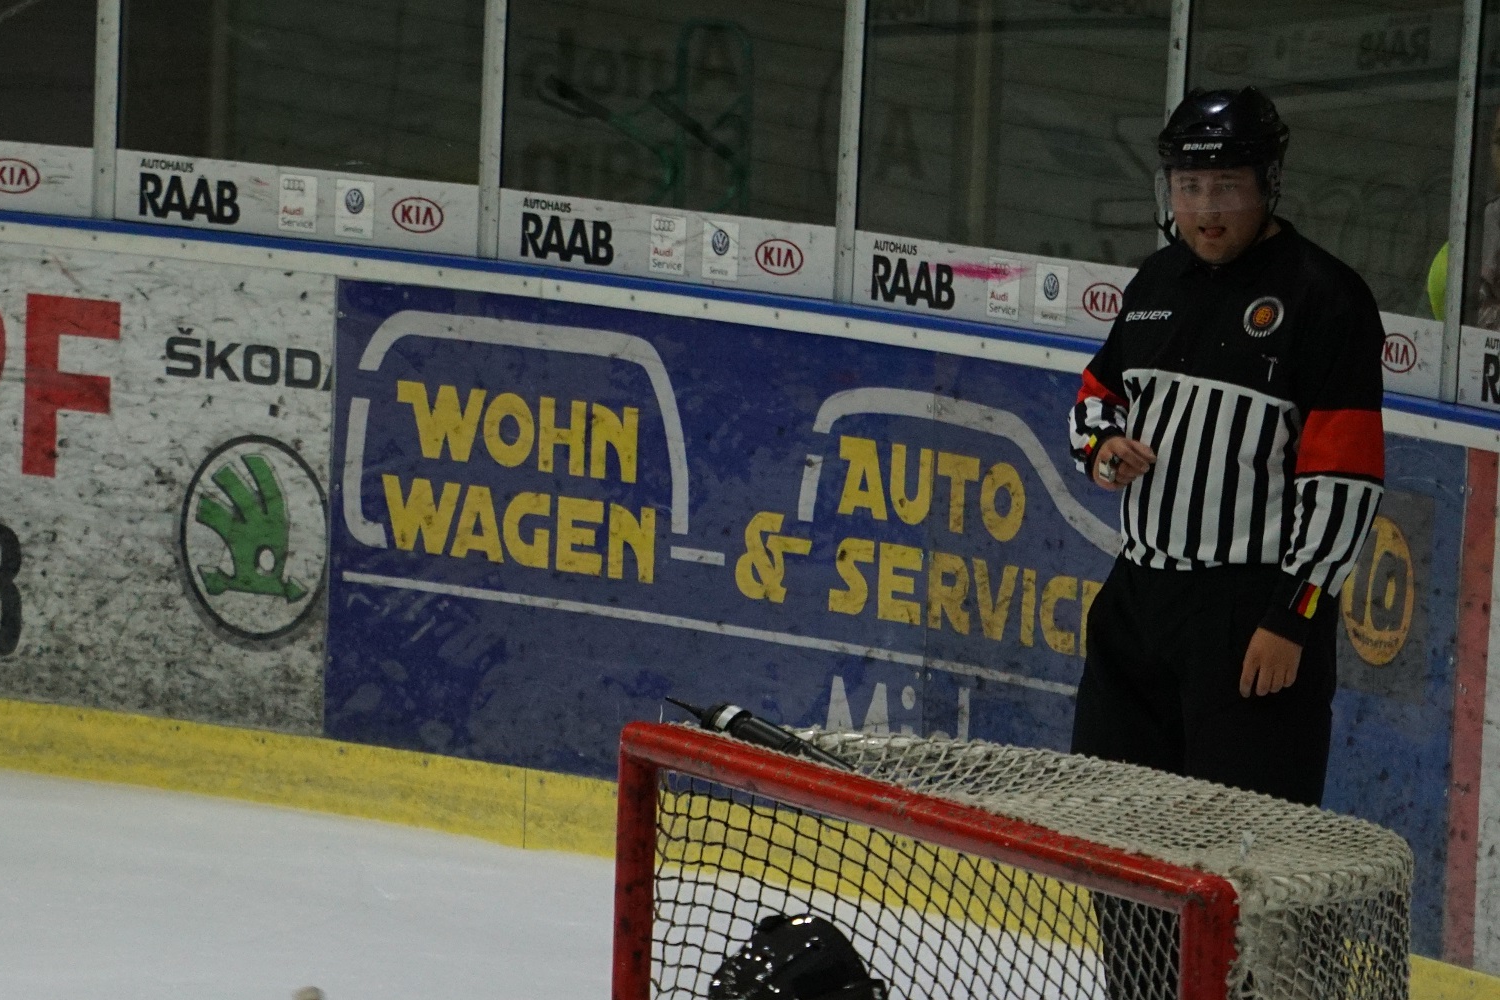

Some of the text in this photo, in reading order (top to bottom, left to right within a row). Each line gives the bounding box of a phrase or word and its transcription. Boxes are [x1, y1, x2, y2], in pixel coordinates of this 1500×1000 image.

[1182, 142, 1223, 151] BAUER
[140, 158, 194, 173] AUTOHAUS
[139, 172, 240, 224] RAAB
[523, 197, 571, 214] AUTOHAUS
[520, 212, 613, 266] RAAB
[653, 247, 673, 258] Audi
[873, 240, 918, 256] AUTOHAUS
[652, 259, 682, 272] Service
[871, 255, 955, 310] RAAB
[990, 291, 1009, 302] Audi
[988, 303, 1017, 316] Service
[1125, 310, 1173, 322] BAUER
[397, 380, 639, 484] WOHN
[837, 435, 1026, 543] AUTO
[382, 473, 656, 584] WAGEN
[735, 511, 813, 604] &
